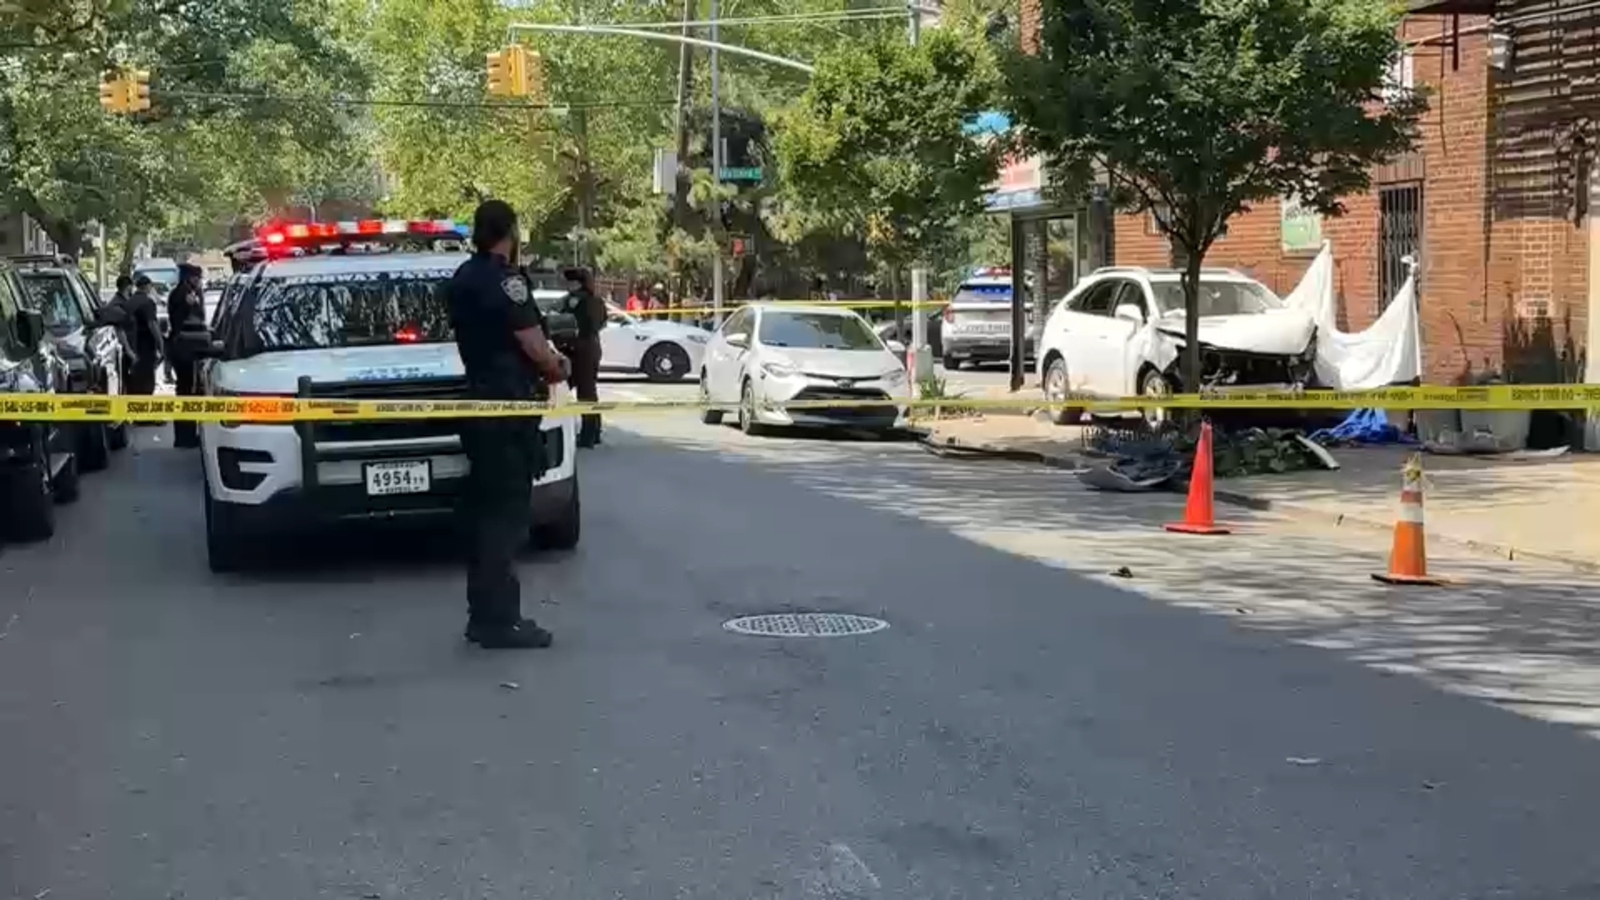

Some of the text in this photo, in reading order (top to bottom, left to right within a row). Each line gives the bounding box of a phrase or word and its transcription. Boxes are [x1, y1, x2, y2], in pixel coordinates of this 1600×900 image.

[286, 268, 454, 285] HIGHWAY PATRO
[373, 469, 411, 488] 4954
